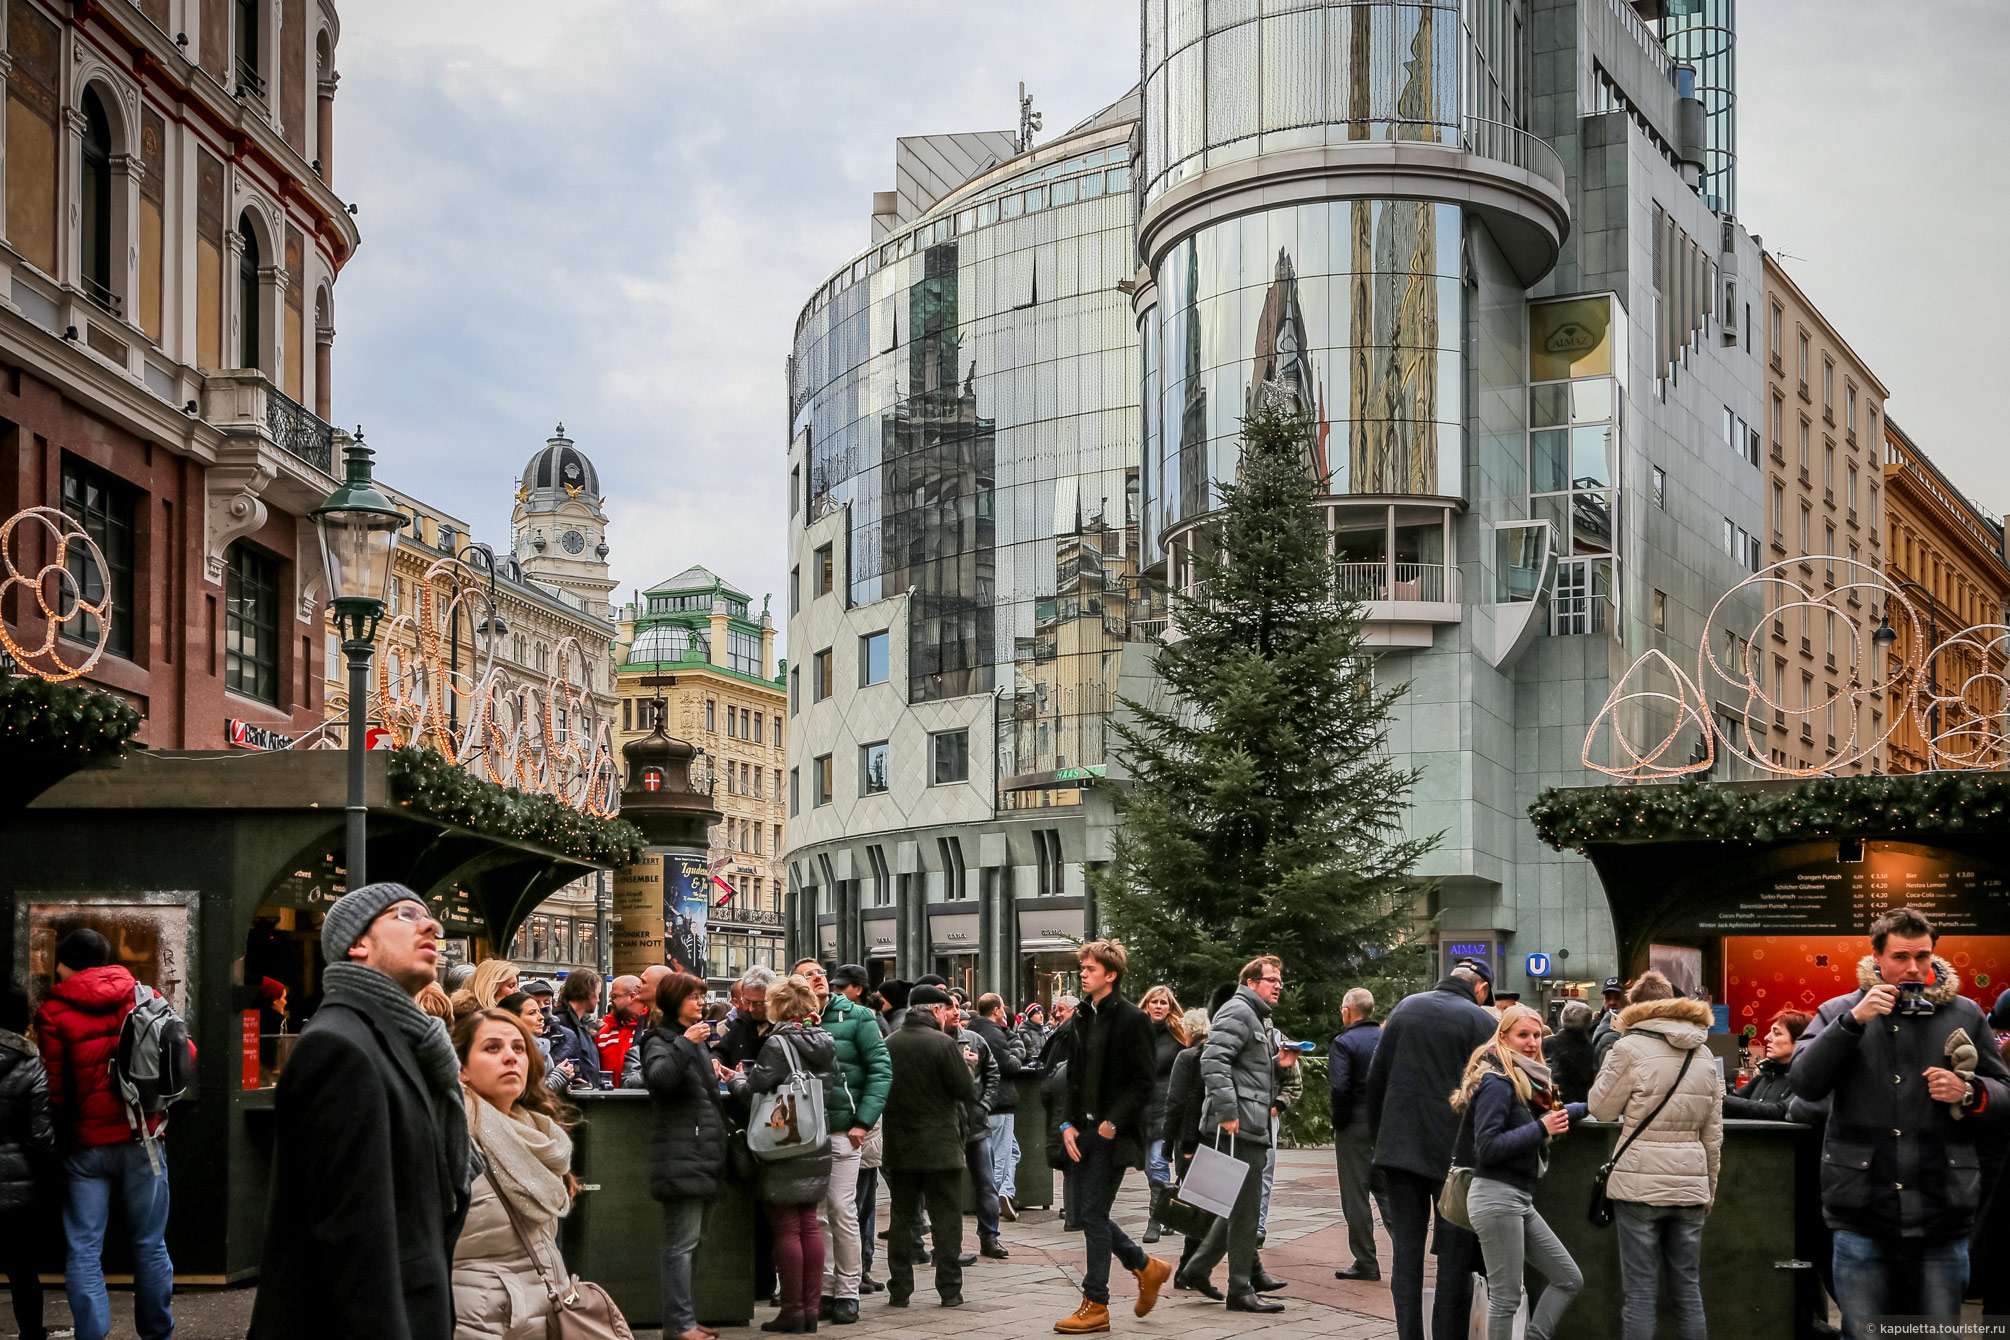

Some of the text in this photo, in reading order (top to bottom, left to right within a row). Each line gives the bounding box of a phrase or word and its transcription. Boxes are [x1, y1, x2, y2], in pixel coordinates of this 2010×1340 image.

[1552, 336, 1589, 348] ALMAZ
[245, 723, 267, 748] Bank
[1056, 768, 1079, 780] HAAS
[946, 932, 967, 940] ZARA
[1040, 928, 1066, 936] ZARA
[639, 939, 662, 948] NOTT
[1450, 944, 1486, 954] ALMAZ
[163, 948, 175, 967] R
[1529, 957, 1546, 975] U
